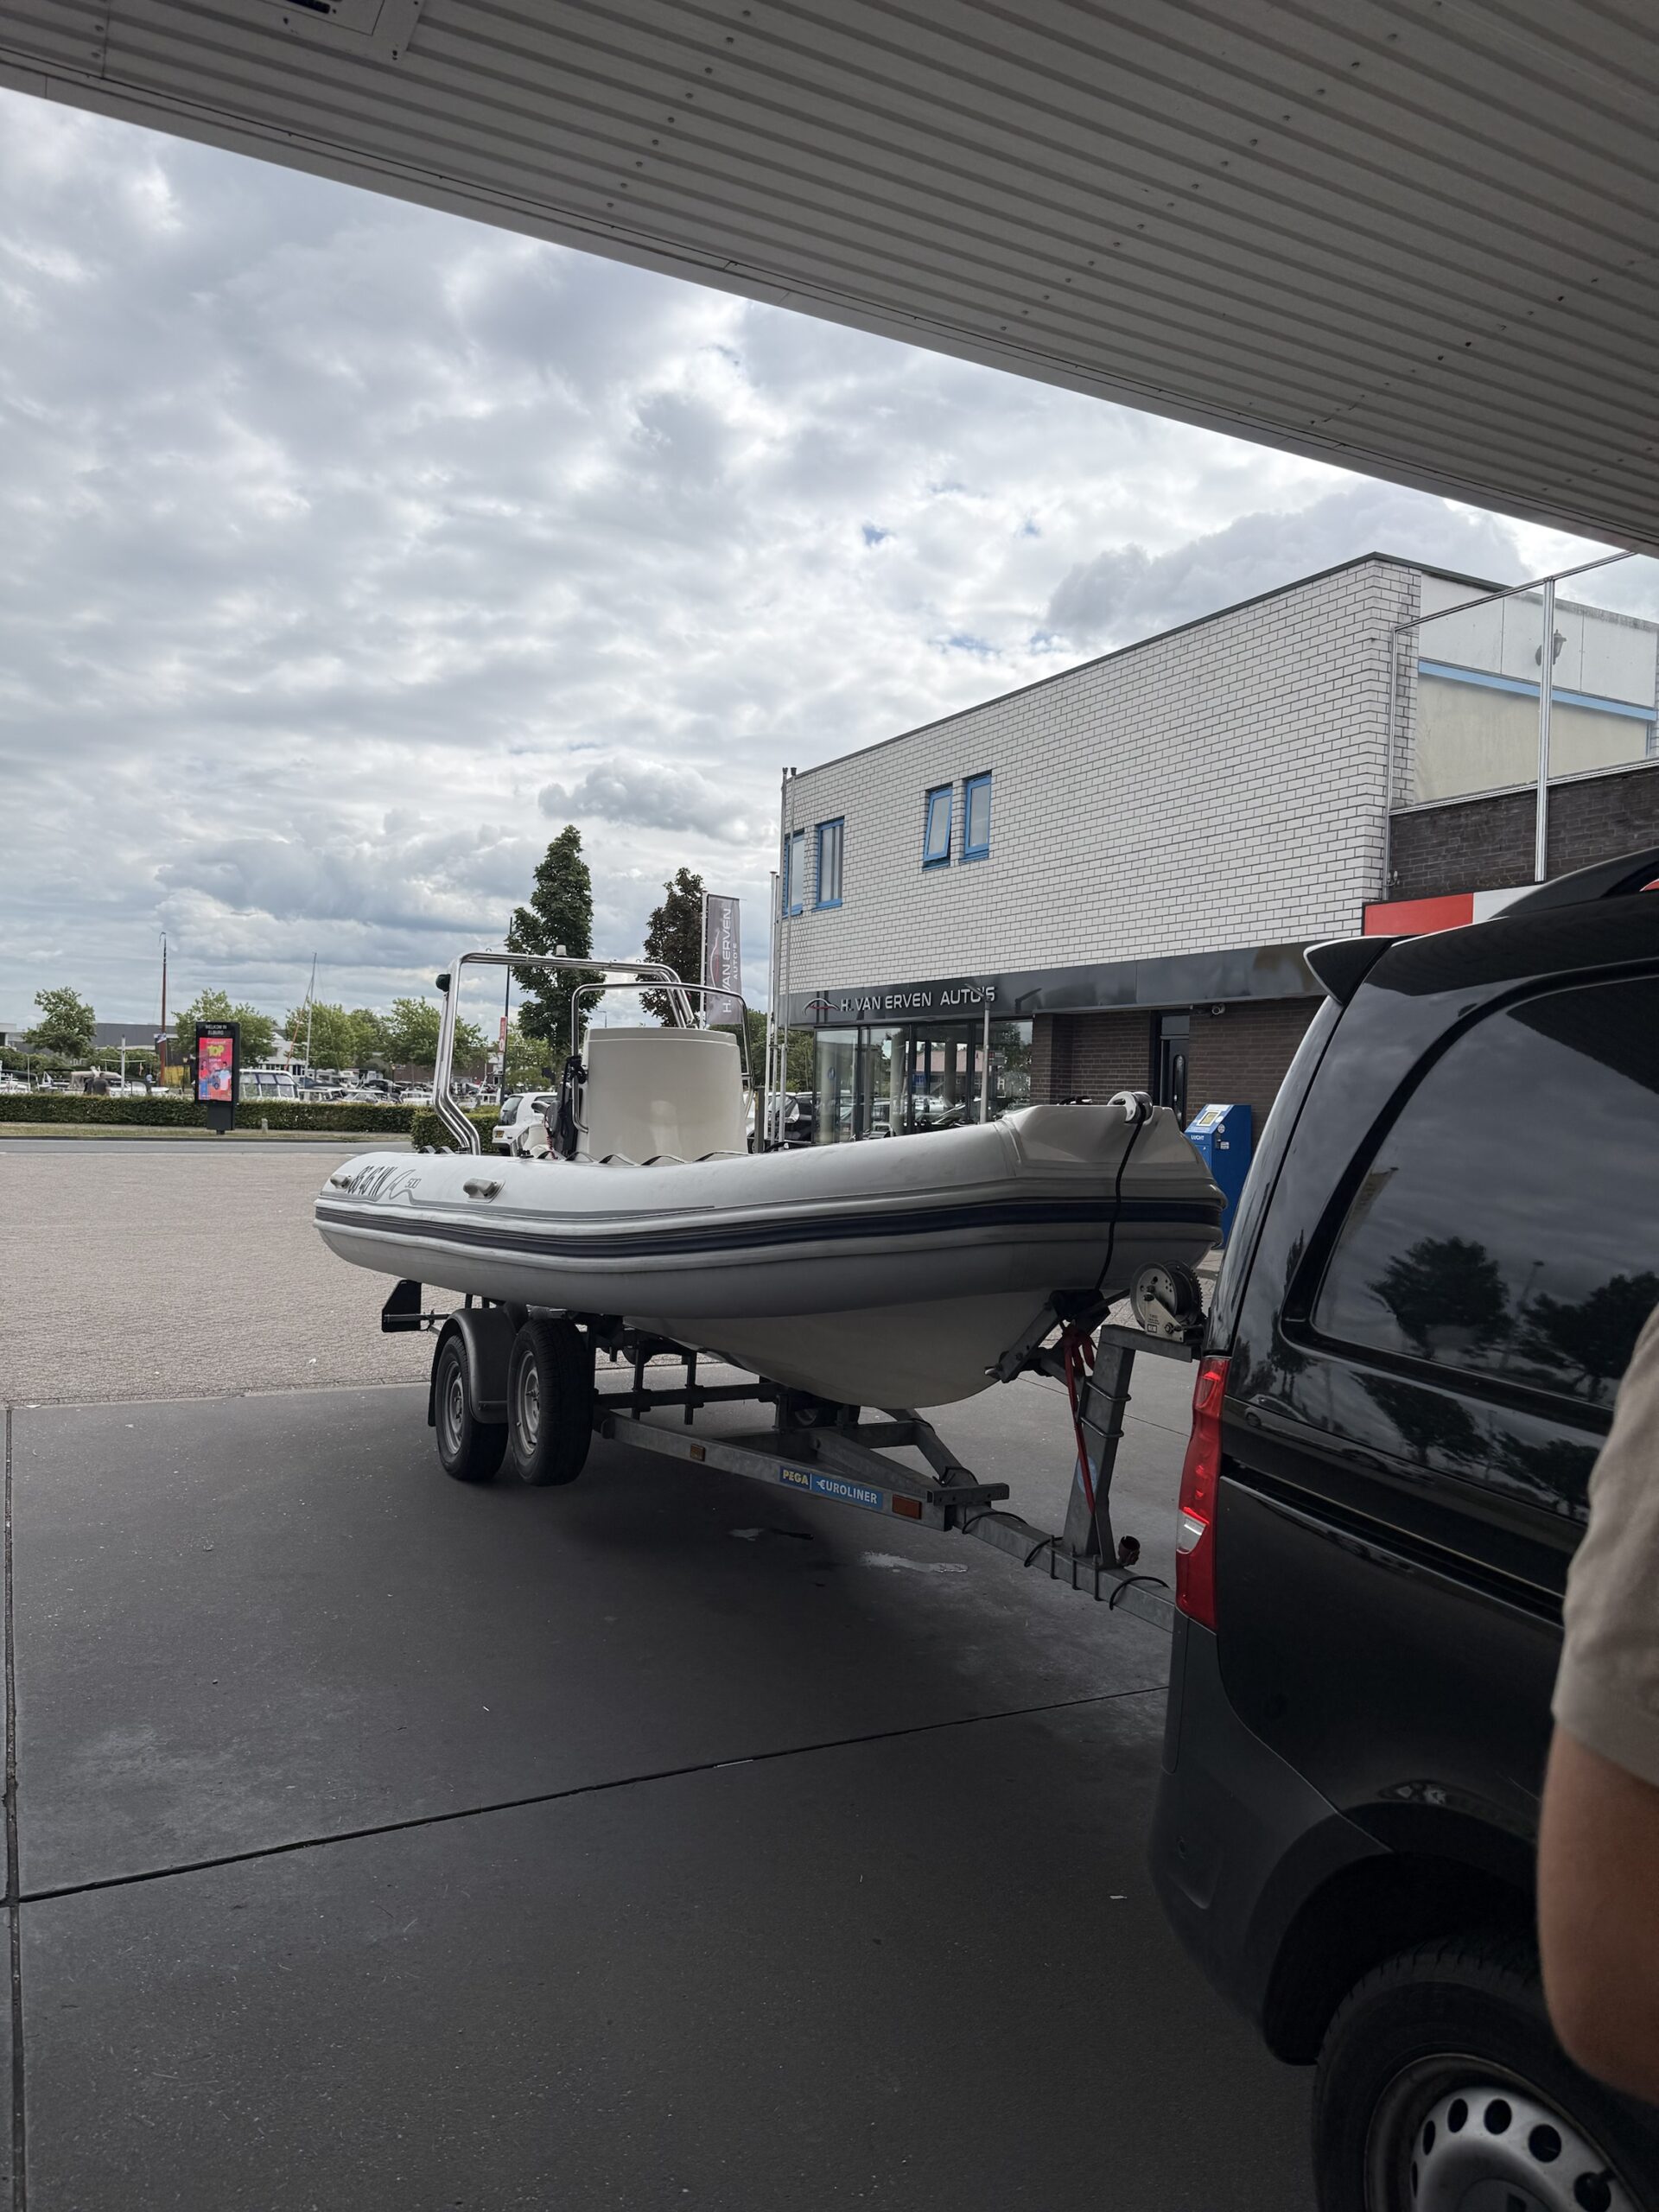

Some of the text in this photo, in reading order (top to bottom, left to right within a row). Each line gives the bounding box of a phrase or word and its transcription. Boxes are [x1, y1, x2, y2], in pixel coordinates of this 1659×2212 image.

[722, 908, 731, 960] ERVEN
[722, 1000, 732, 1013] H.
[840, 986, 995, 1012] H. VAN ERVEN AUTO'S
[783, 1469, 809, 1485] PEGA
